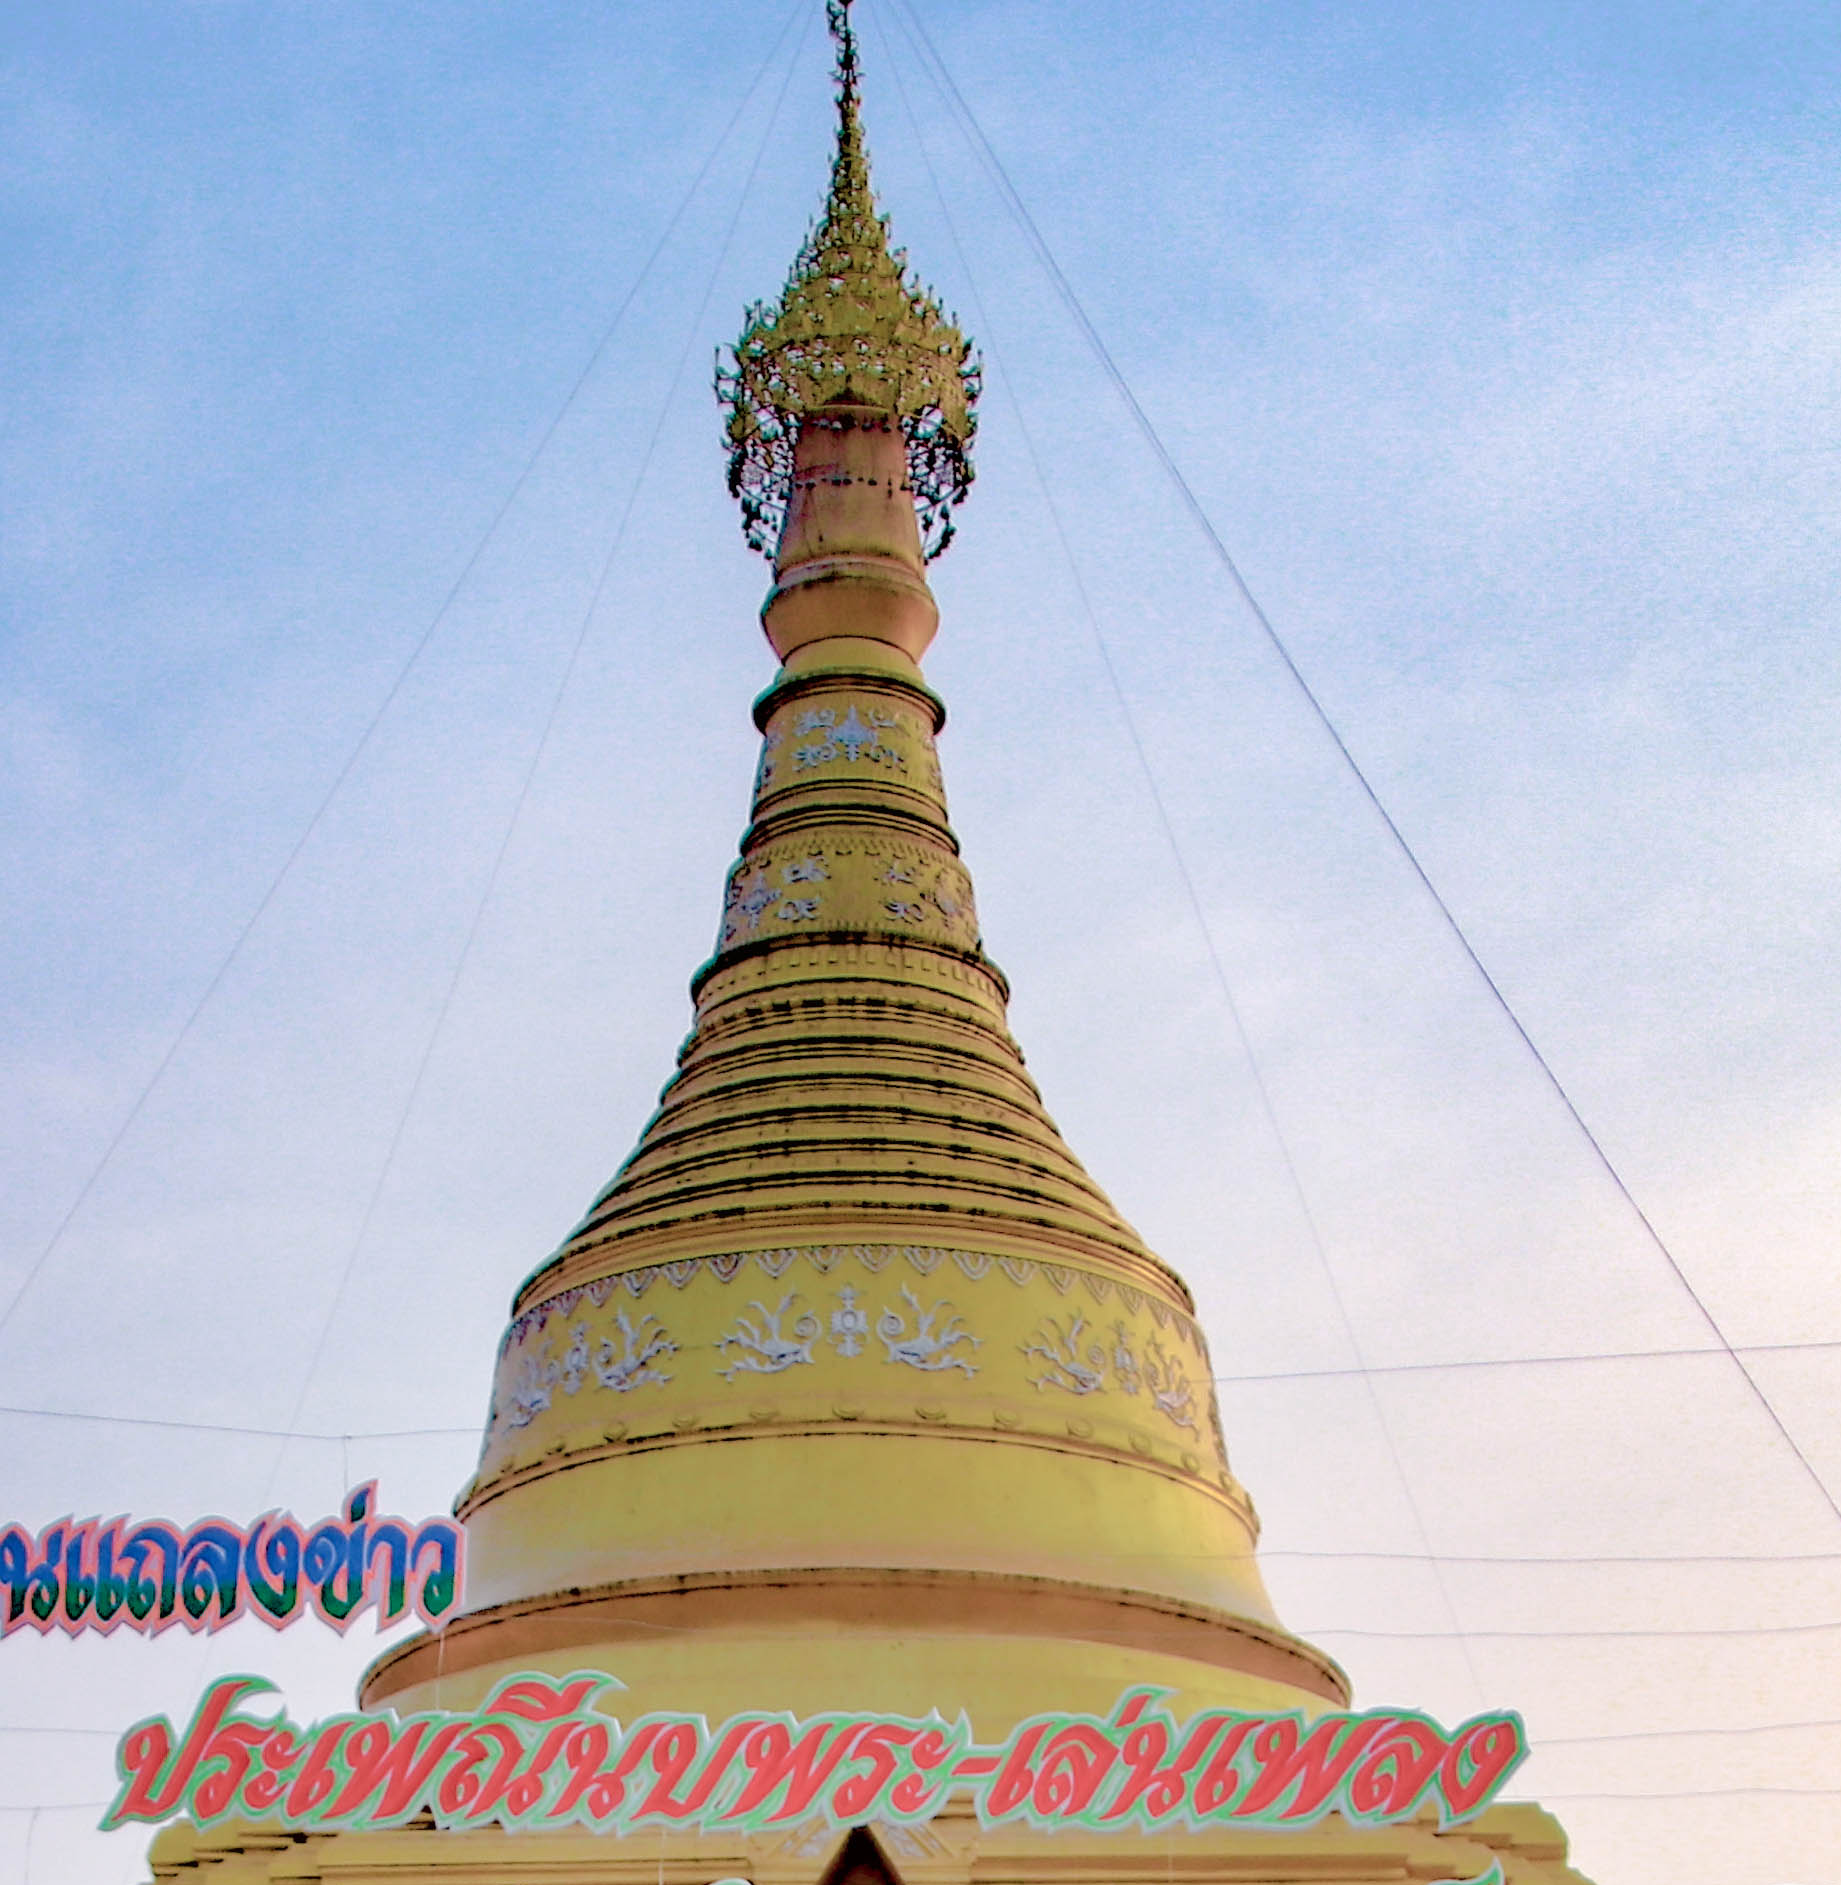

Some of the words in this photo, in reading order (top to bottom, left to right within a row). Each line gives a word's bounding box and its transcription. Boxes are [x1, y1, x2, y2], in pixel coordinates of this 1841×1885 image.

[104, 1674, 1528, 1832] ประเพณีนบพระ-เล่นเพลง
